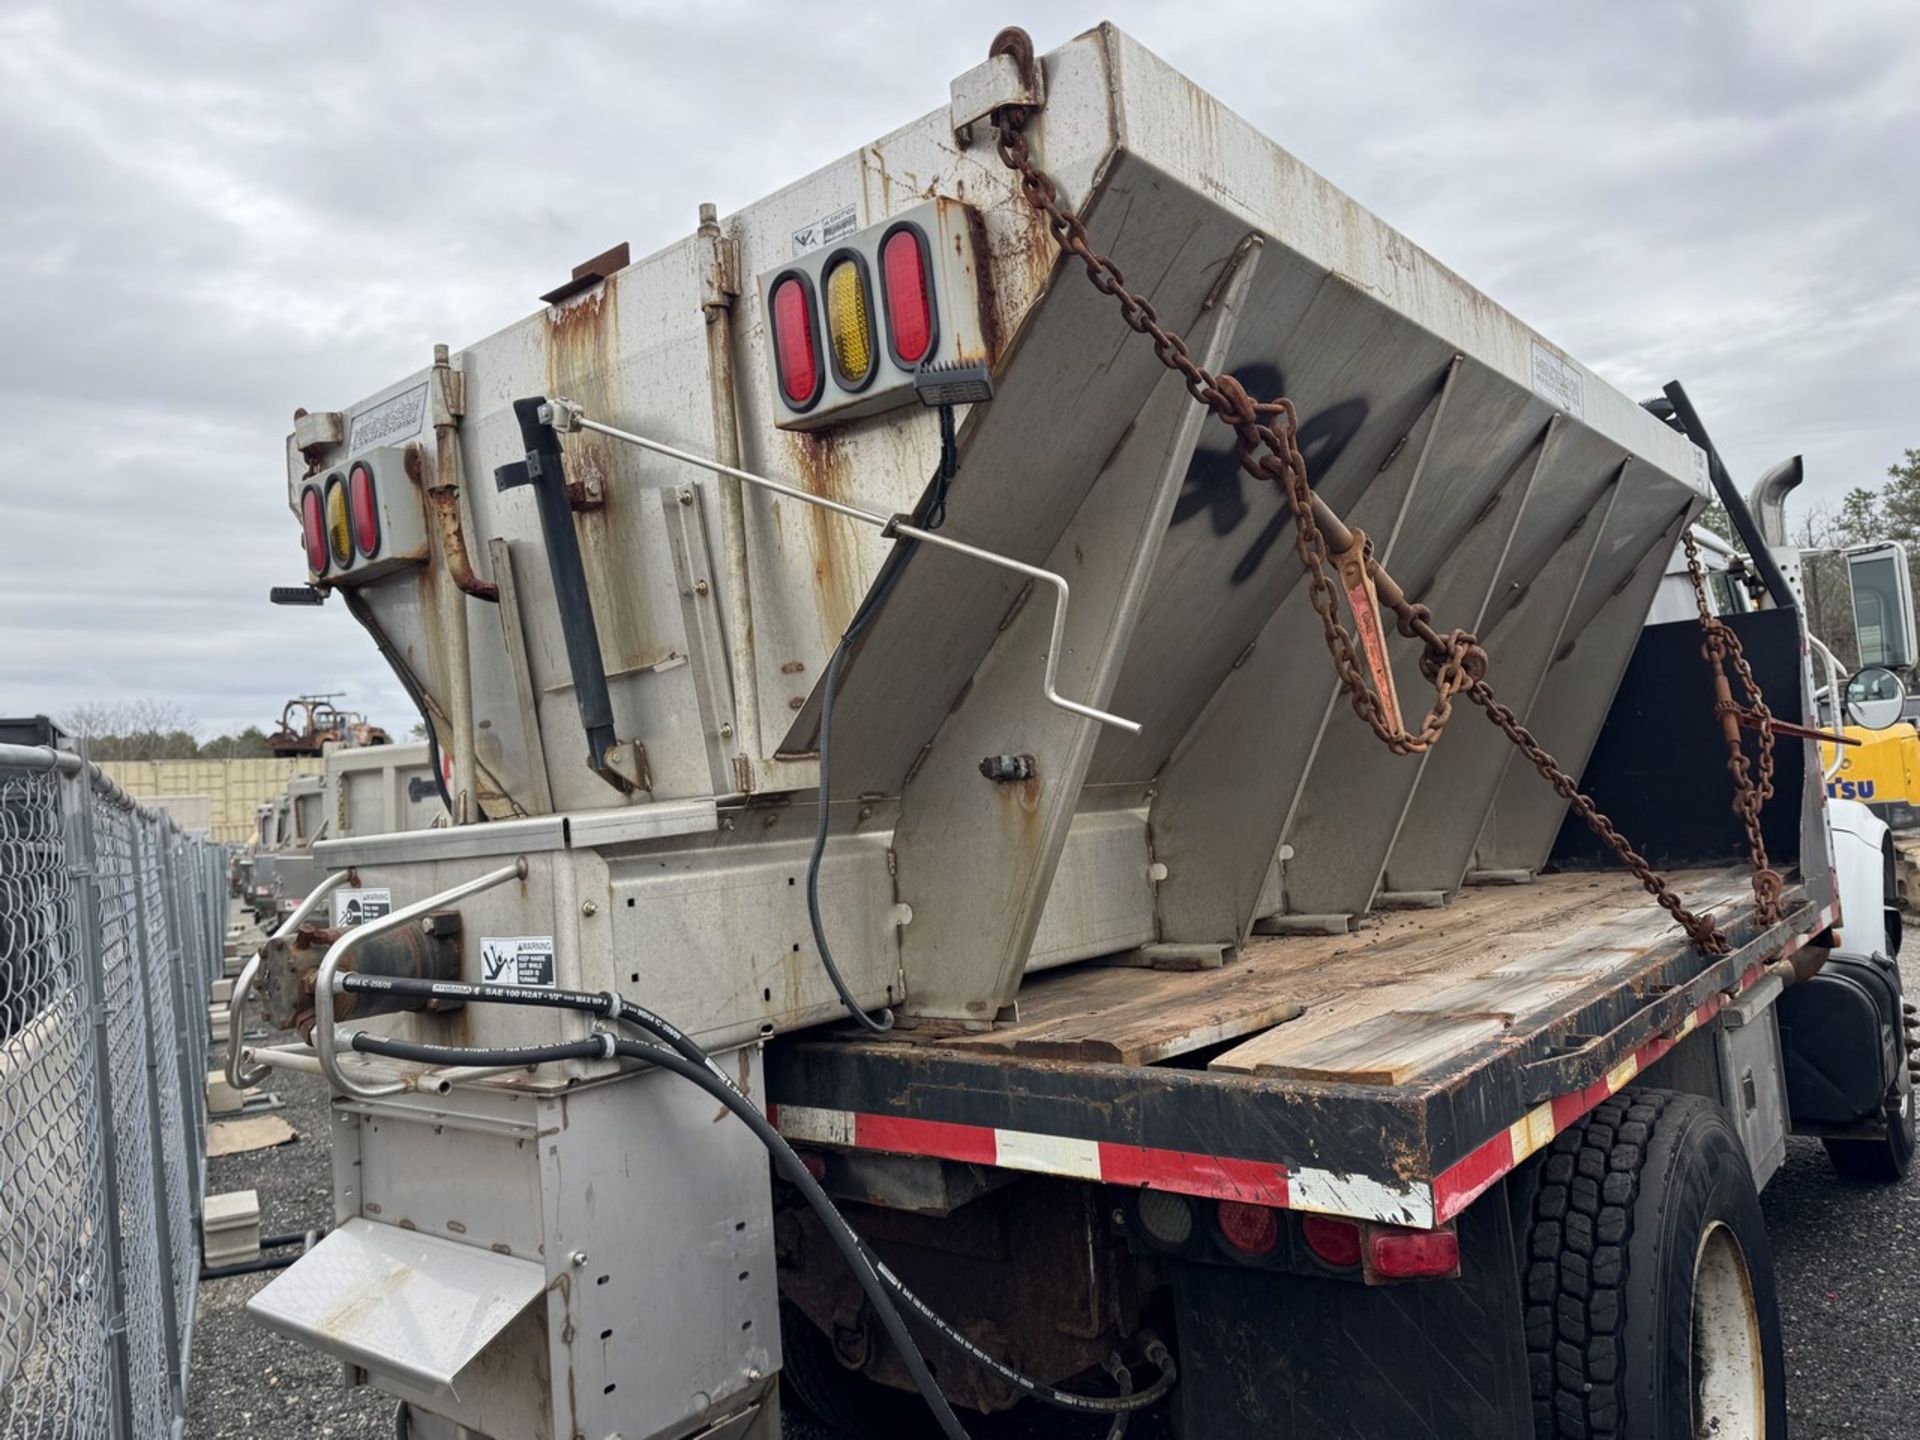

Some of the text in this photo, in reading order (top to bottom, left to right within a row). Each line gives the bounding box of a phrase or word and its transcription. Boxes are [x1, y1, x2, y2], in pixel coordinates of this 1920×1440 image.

[523, 942, 551, 950] WARNING
[485, 987, 504, 996] SAE
[506, 989, 520, 998] 100
